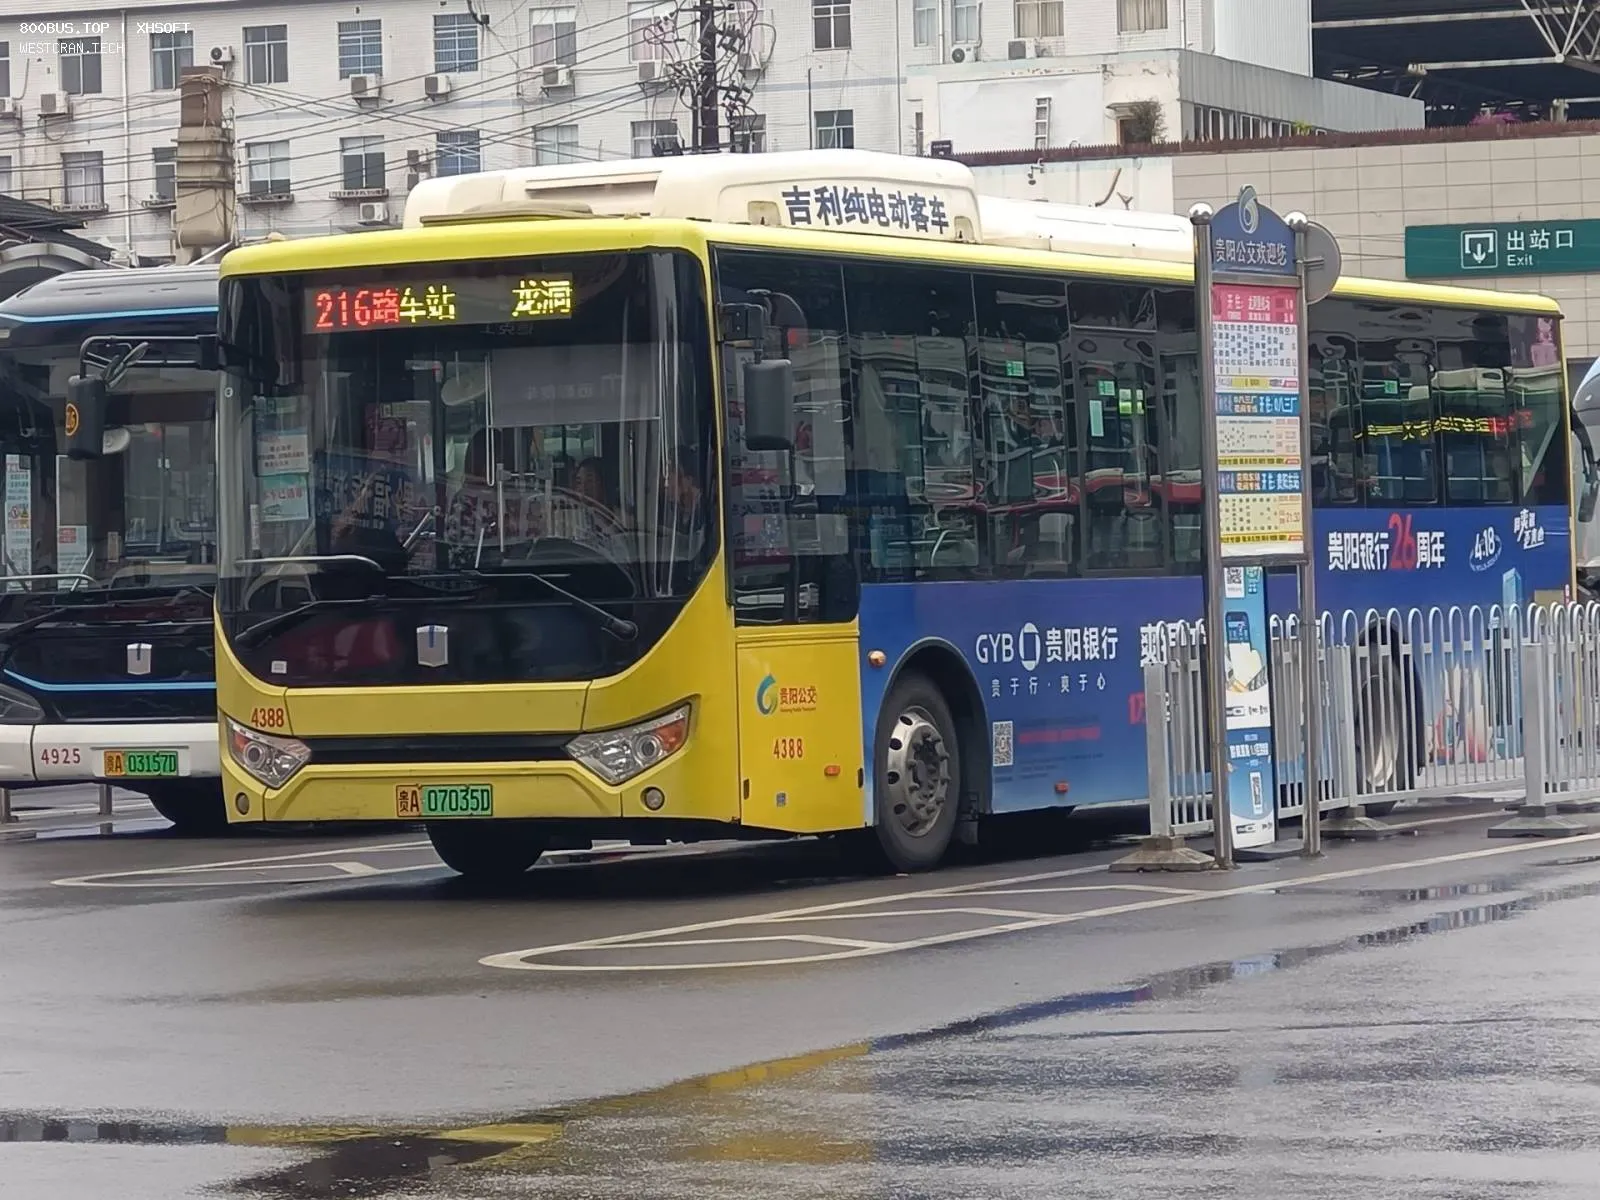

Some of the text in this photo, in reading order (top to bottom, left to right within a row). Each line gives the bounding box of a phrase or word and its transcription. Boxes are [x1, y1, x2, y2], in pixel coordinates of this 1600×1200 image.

[781, 185, 949, 234] 吉利纯电动客车
[1507, 229, 1574, 251] 出站口
[1215, 238, 1287, 266] 贵阳公交欢迎您
[1507, 254, 1534, 267] Exit
[975, 633, 1014, 664] GYB
[1045, 626, 1118, 663] 贵阳银行
[779, 686, 817, 705] 贵阳公交
[251, 707, 285, 728] 4388
[41, 748, 81, 764] 4925
[773, 738, 803, 759] 4388
